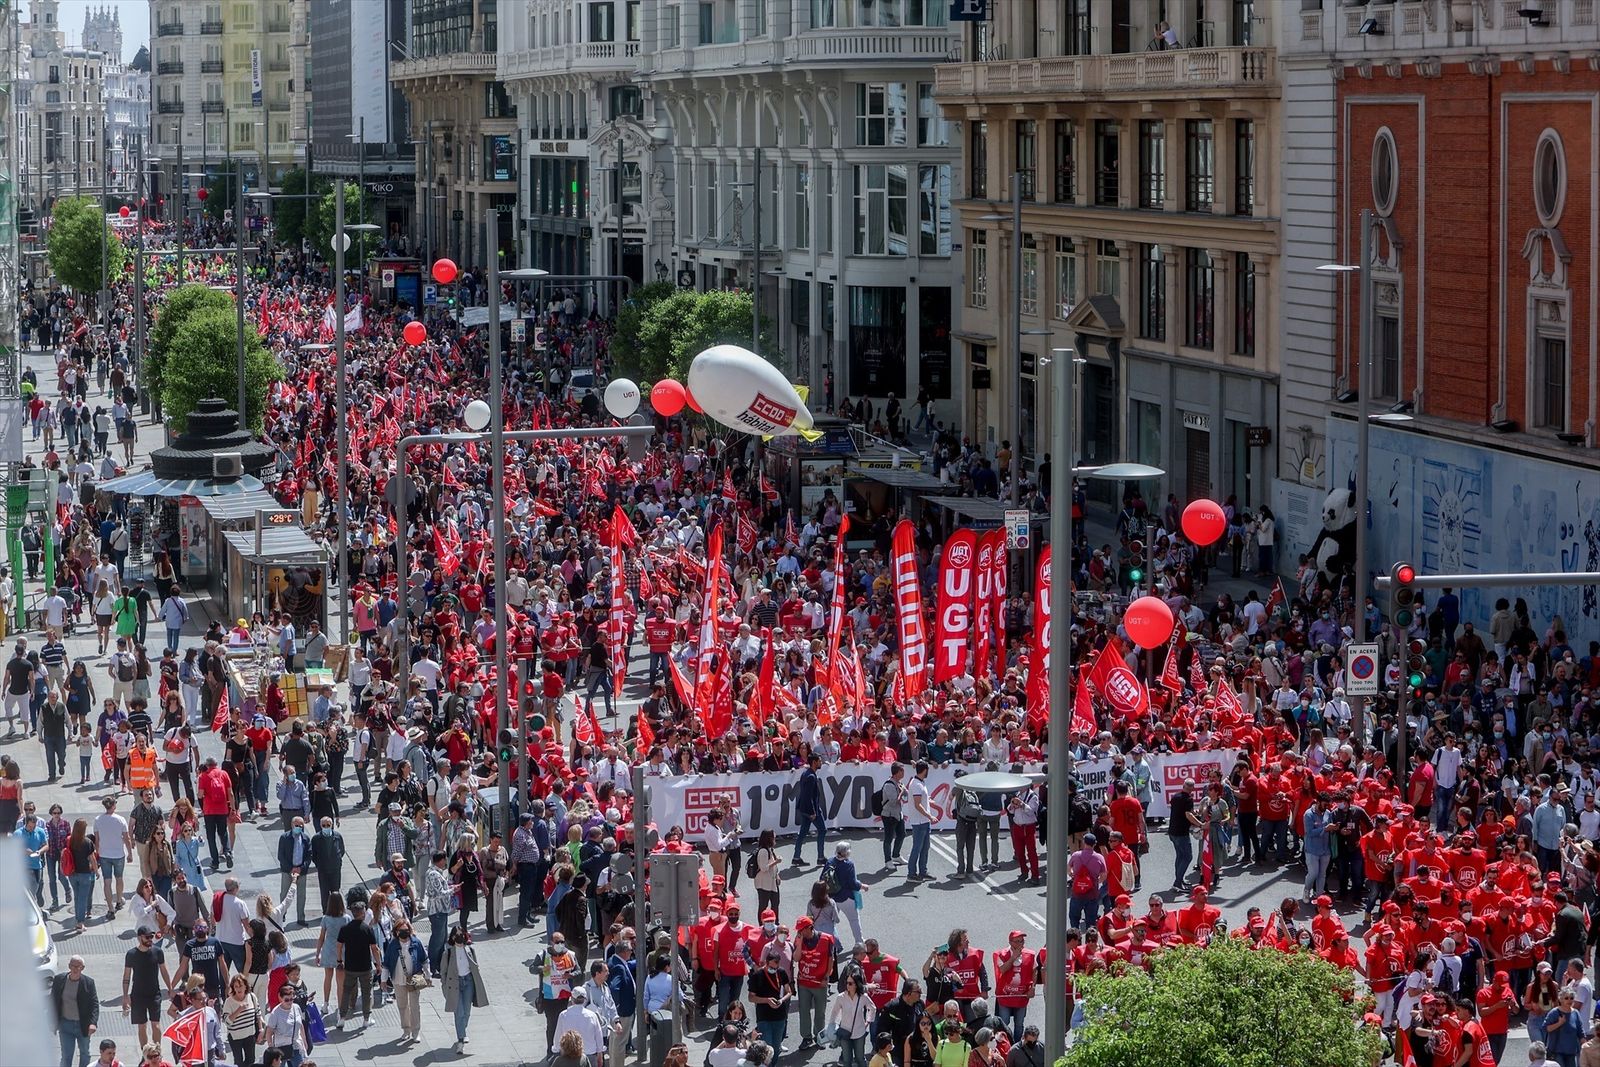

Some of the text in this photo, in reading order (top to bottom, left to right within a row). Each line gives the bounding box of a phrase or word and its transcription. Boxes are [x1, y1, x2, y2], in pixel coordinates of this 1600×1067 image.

[372, 184, 394, 193] KIKO
[753, 398, 786, 421] CCOO
[737, 410, 776, 433] hábitat
[269, 514, 293, 523] +29°C
[953, 546, 968, 560] UGT
[943, 568, 971, 666] UGT
[1110, 670, 1139, 702] UGT
[1168, 766, 1198, 780] UGT
[686, 815, 710, 832] UG
[1460, 870, 1476, 881] UGT
[191, 945, 216, 954] SUNDAY
[191, 952, 216, 961] FUNDAY
